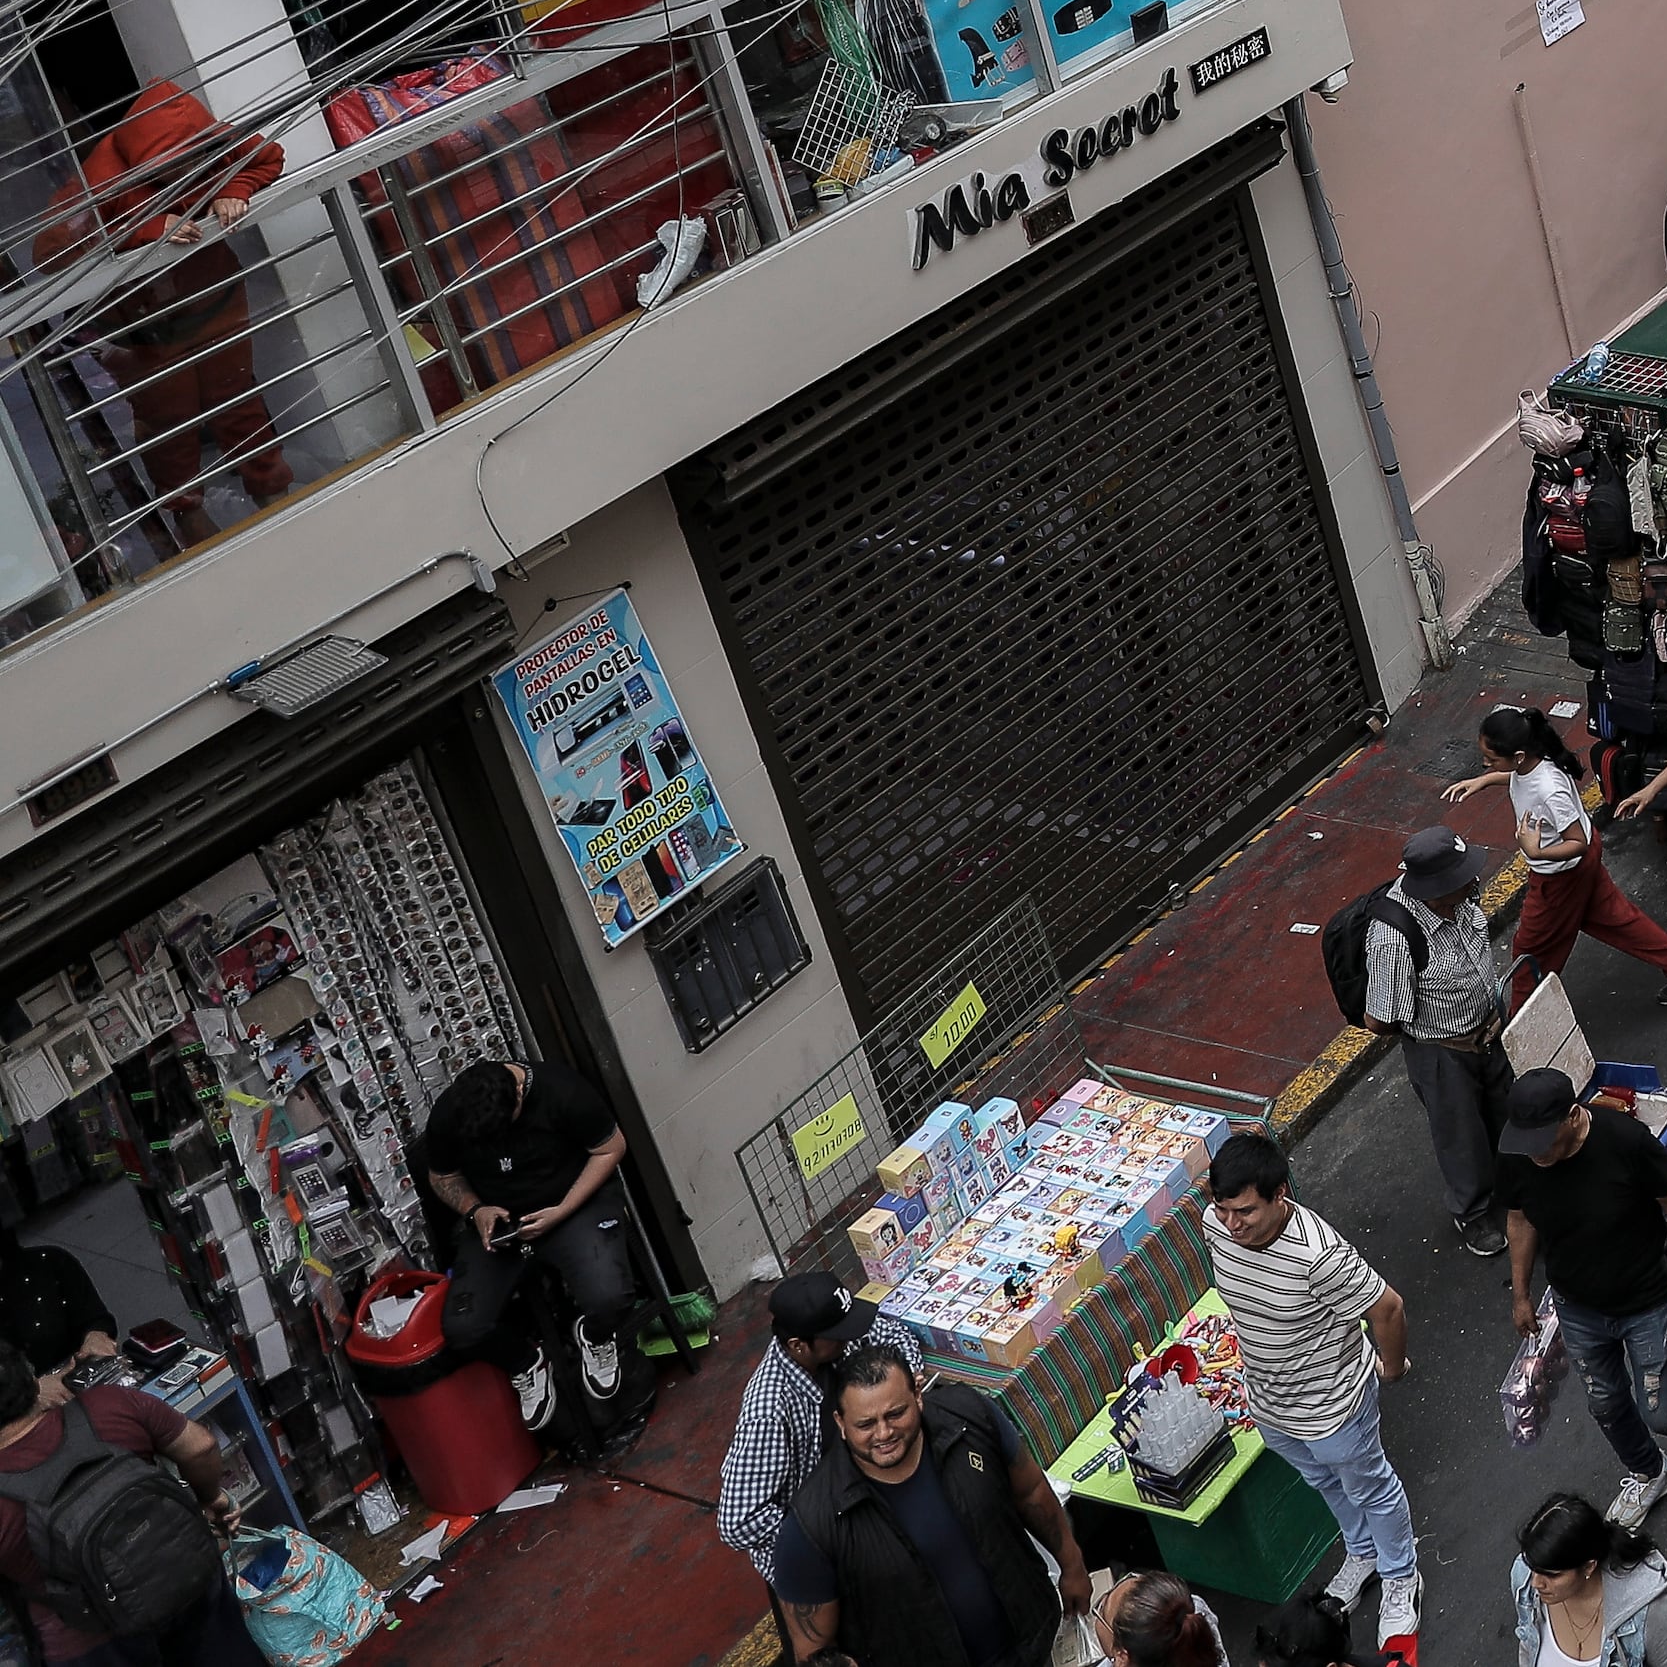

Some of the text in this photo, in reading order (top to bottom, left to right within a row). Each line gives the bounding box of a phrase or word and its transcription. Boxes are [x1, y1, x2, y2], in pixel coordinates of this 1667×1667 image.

[1196, 34, 1265, 88] 我的秘密
[911, 66, 1182, 271] Mia Secret
[516, 609, 609, 681] PROTECTOR DE
[524, 628, 616, 698] PANTALLAS EN
[527, 645, 642, 733] HIDROGEL
[587, 777, 688, 858] PAR TODO TIPO
[601, 797, 693, 874] DE CELULARES
[942, 1001, 977, 1048] 10.00
